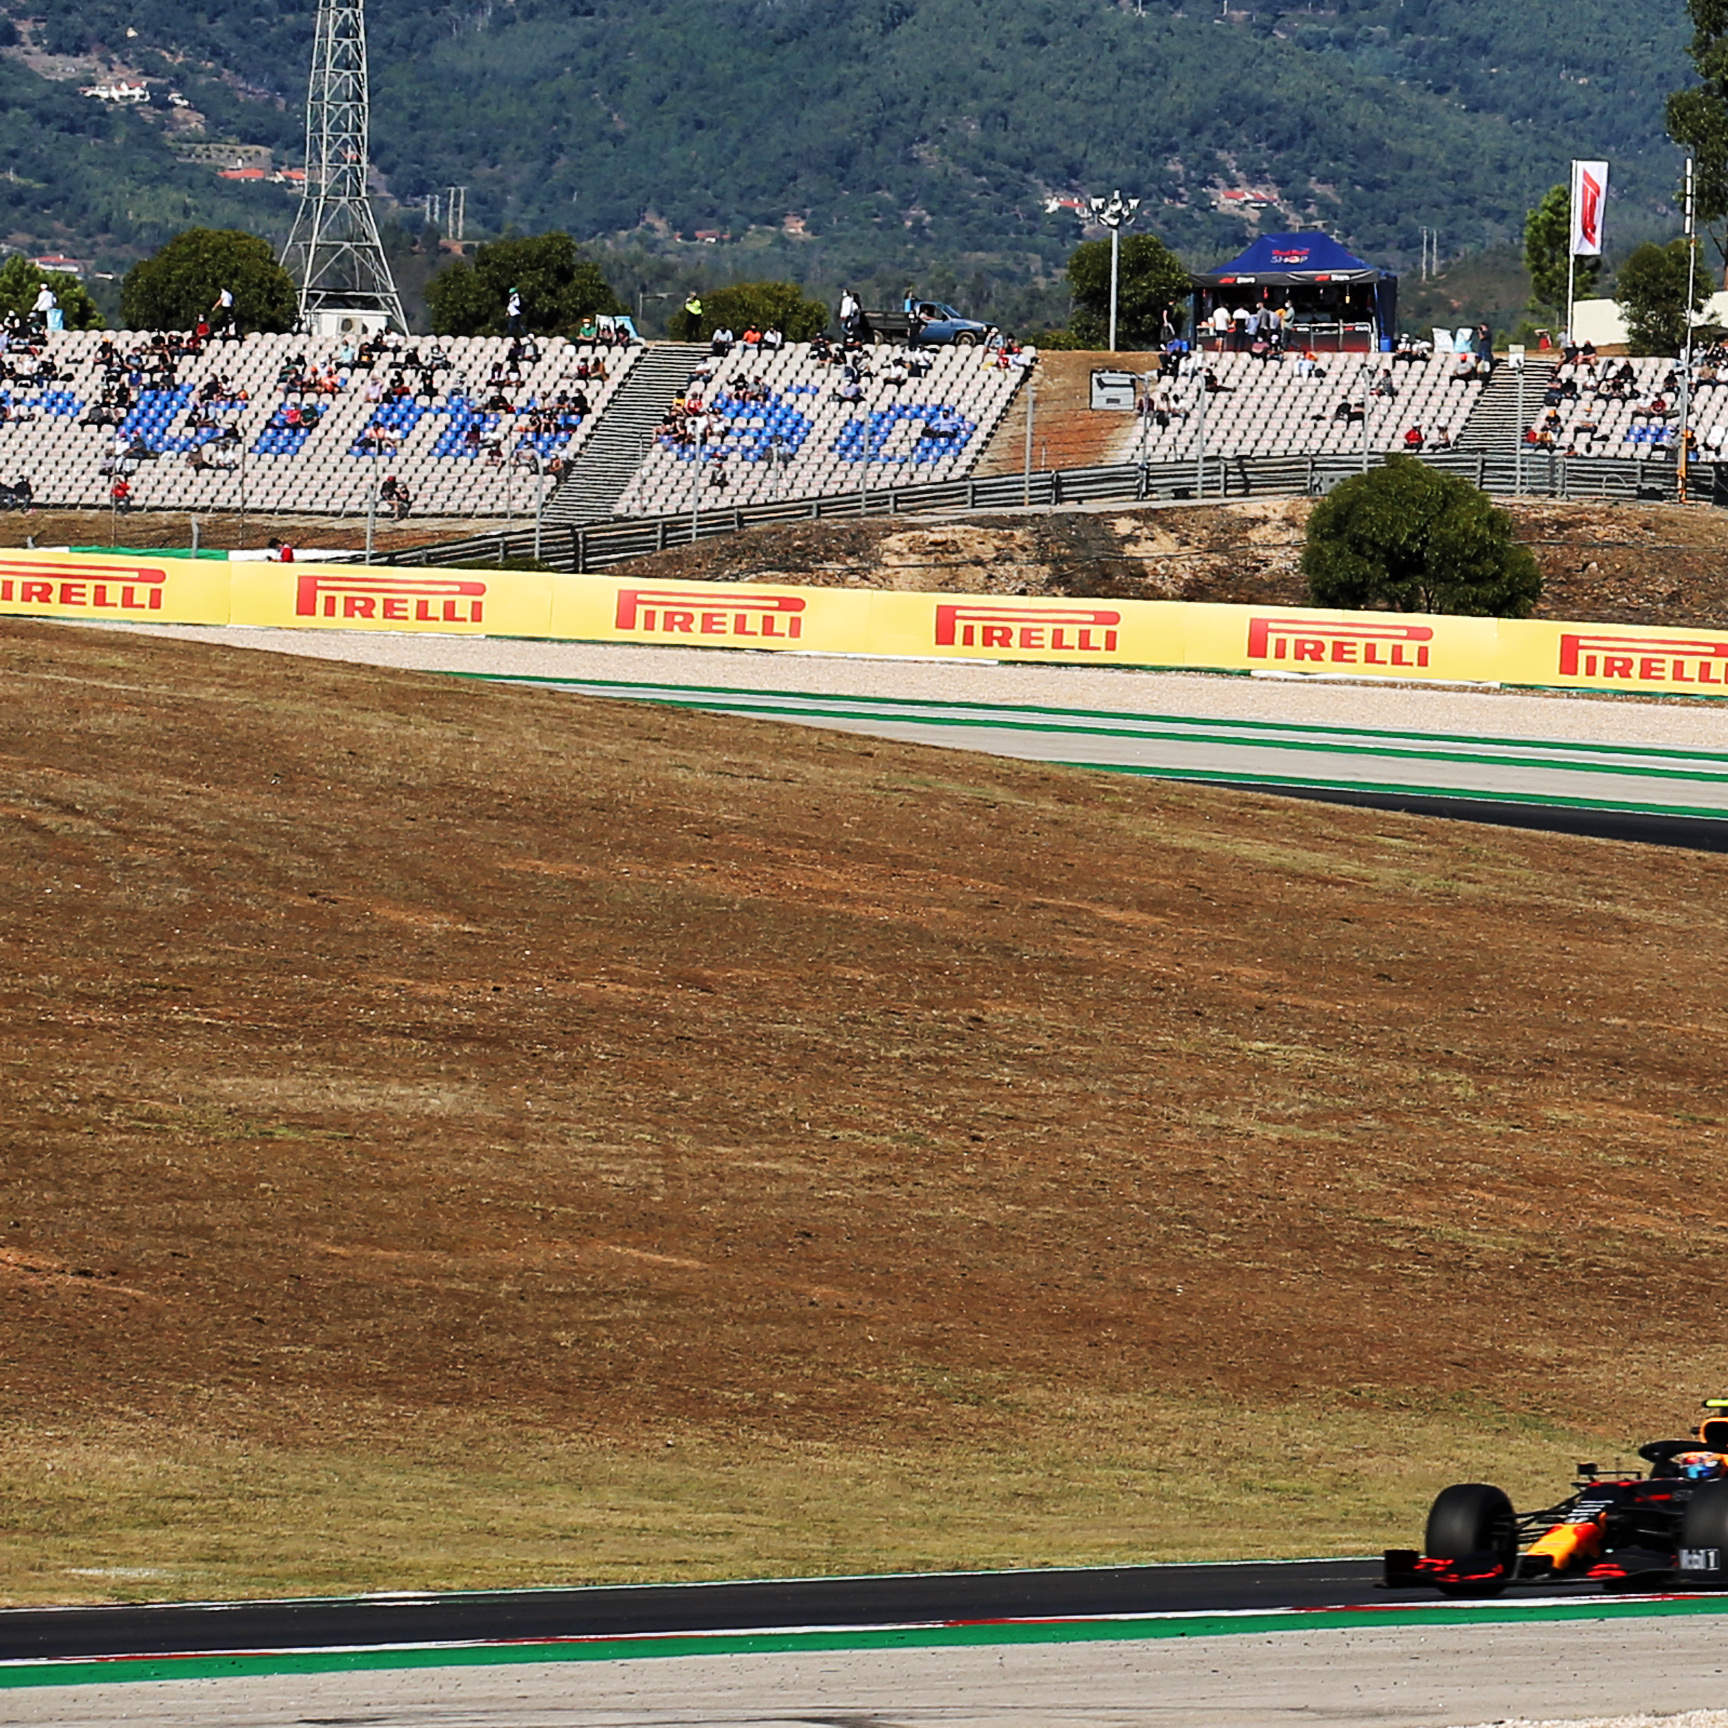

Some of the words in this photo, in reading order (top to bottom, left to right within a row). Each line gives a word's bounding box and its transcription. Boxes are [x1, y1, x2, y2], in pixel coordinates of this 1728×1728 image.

[296, 575, 487, 623] PIRELLI
[616, 590, 806, 638] PIRELLI
[935, 604, 1121, 652] PIRELLI
[1247, 618, 1434, 668] PIRELLI
